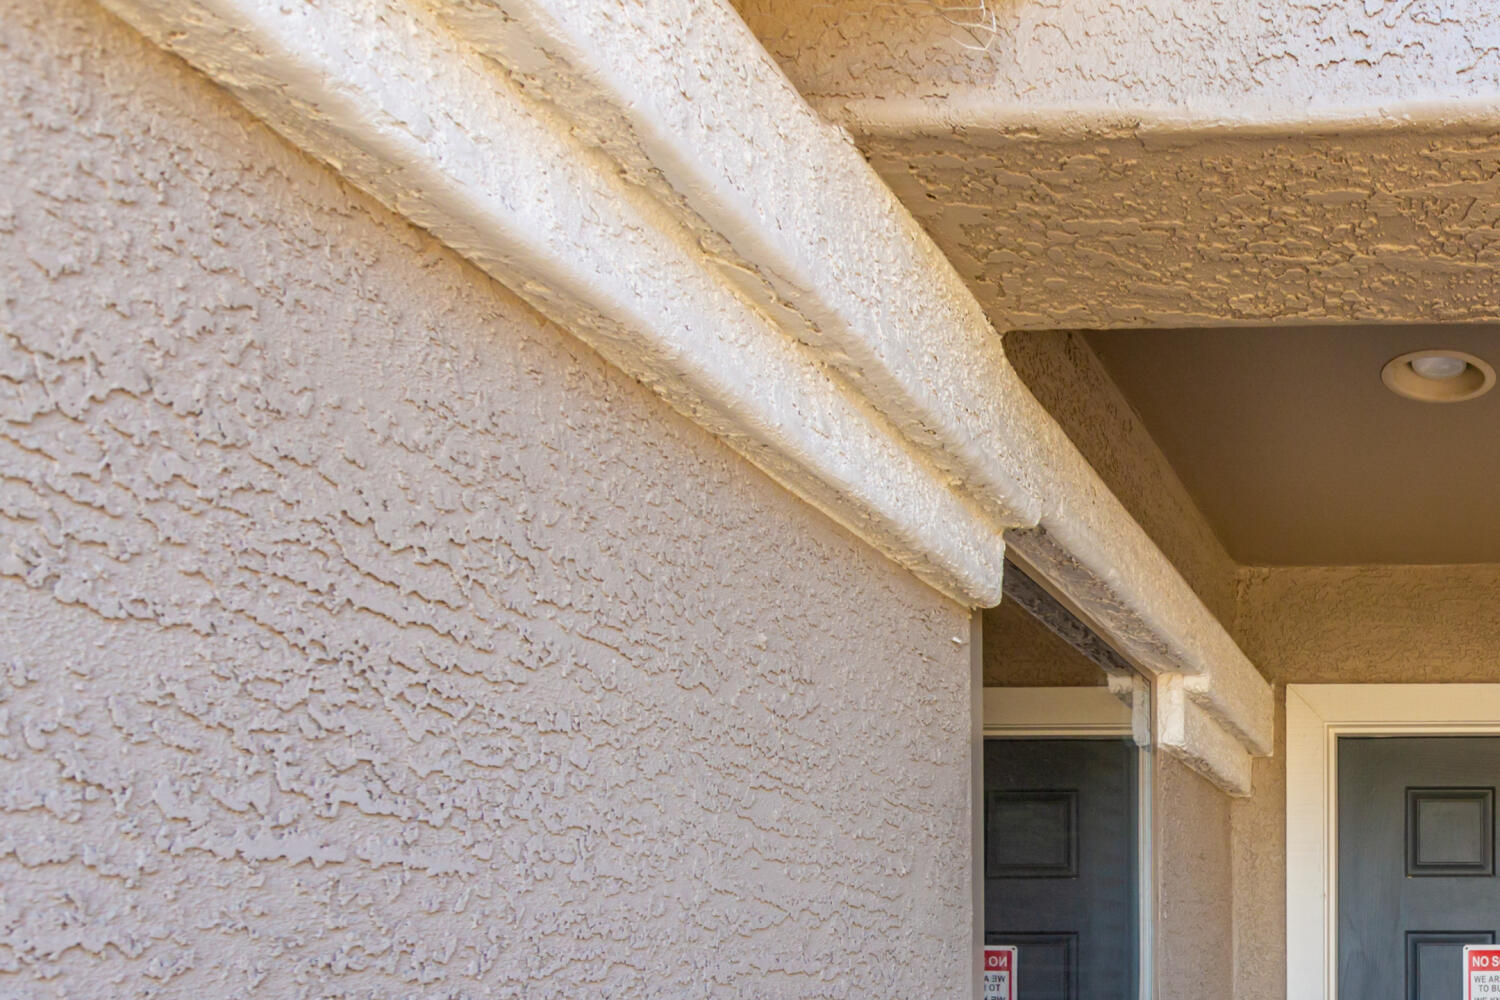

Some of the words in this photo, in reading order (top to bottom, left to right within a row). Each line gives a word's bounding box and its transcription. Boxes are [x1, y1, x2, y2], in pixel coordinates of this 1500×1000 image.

[1472, 955, 1490, 967] NO
[1474, 975, 1486, 983] WE
[1478, 985, 1490, 993] TO
